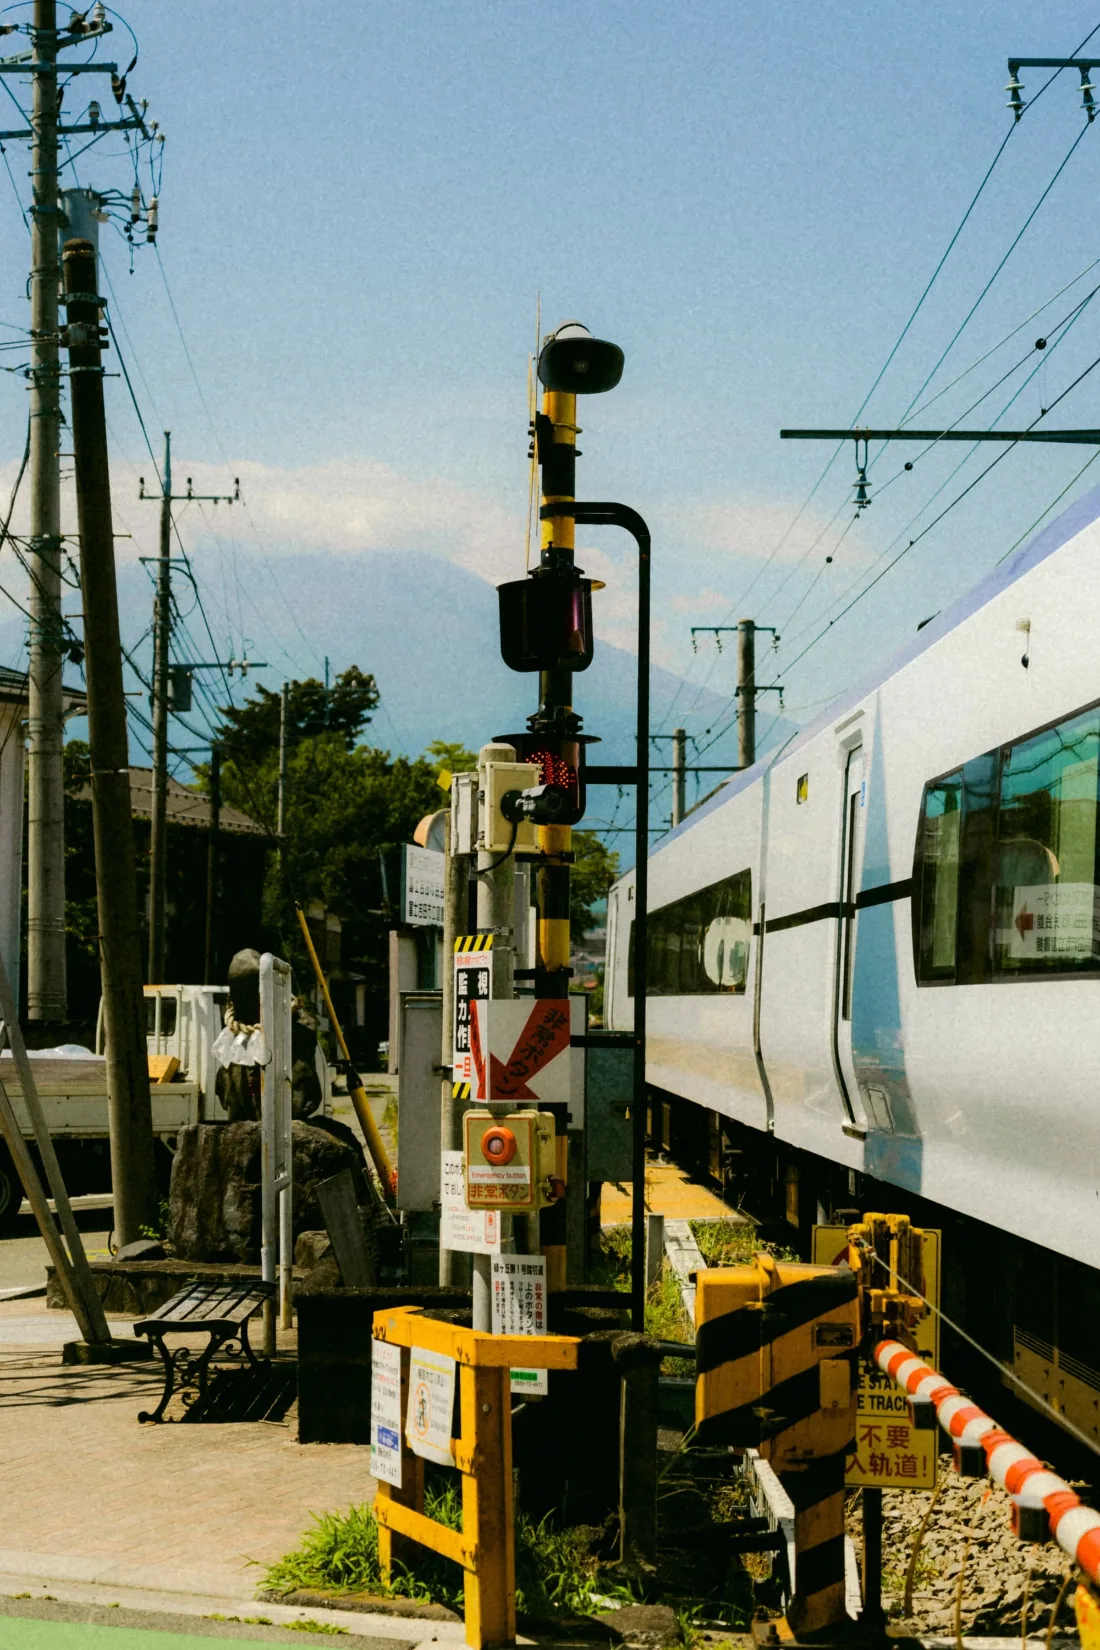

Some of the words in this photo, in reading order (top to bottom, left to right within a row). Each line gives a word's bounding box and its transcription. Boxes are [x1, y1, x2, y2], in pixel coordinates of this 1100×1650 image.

[457, 971, 489, 996] 監視
[457, 1024, 470, 1049] 作
[496, 1008, 568, 1094] 非常ボタン
[471, 1172, 505, 1180] Emergency
[470, 1184, 530, 1199] 非常ボタン
[535, 1282, 543, 1330] 非常の際は
[859, 1424, 910, 1449] 不要
